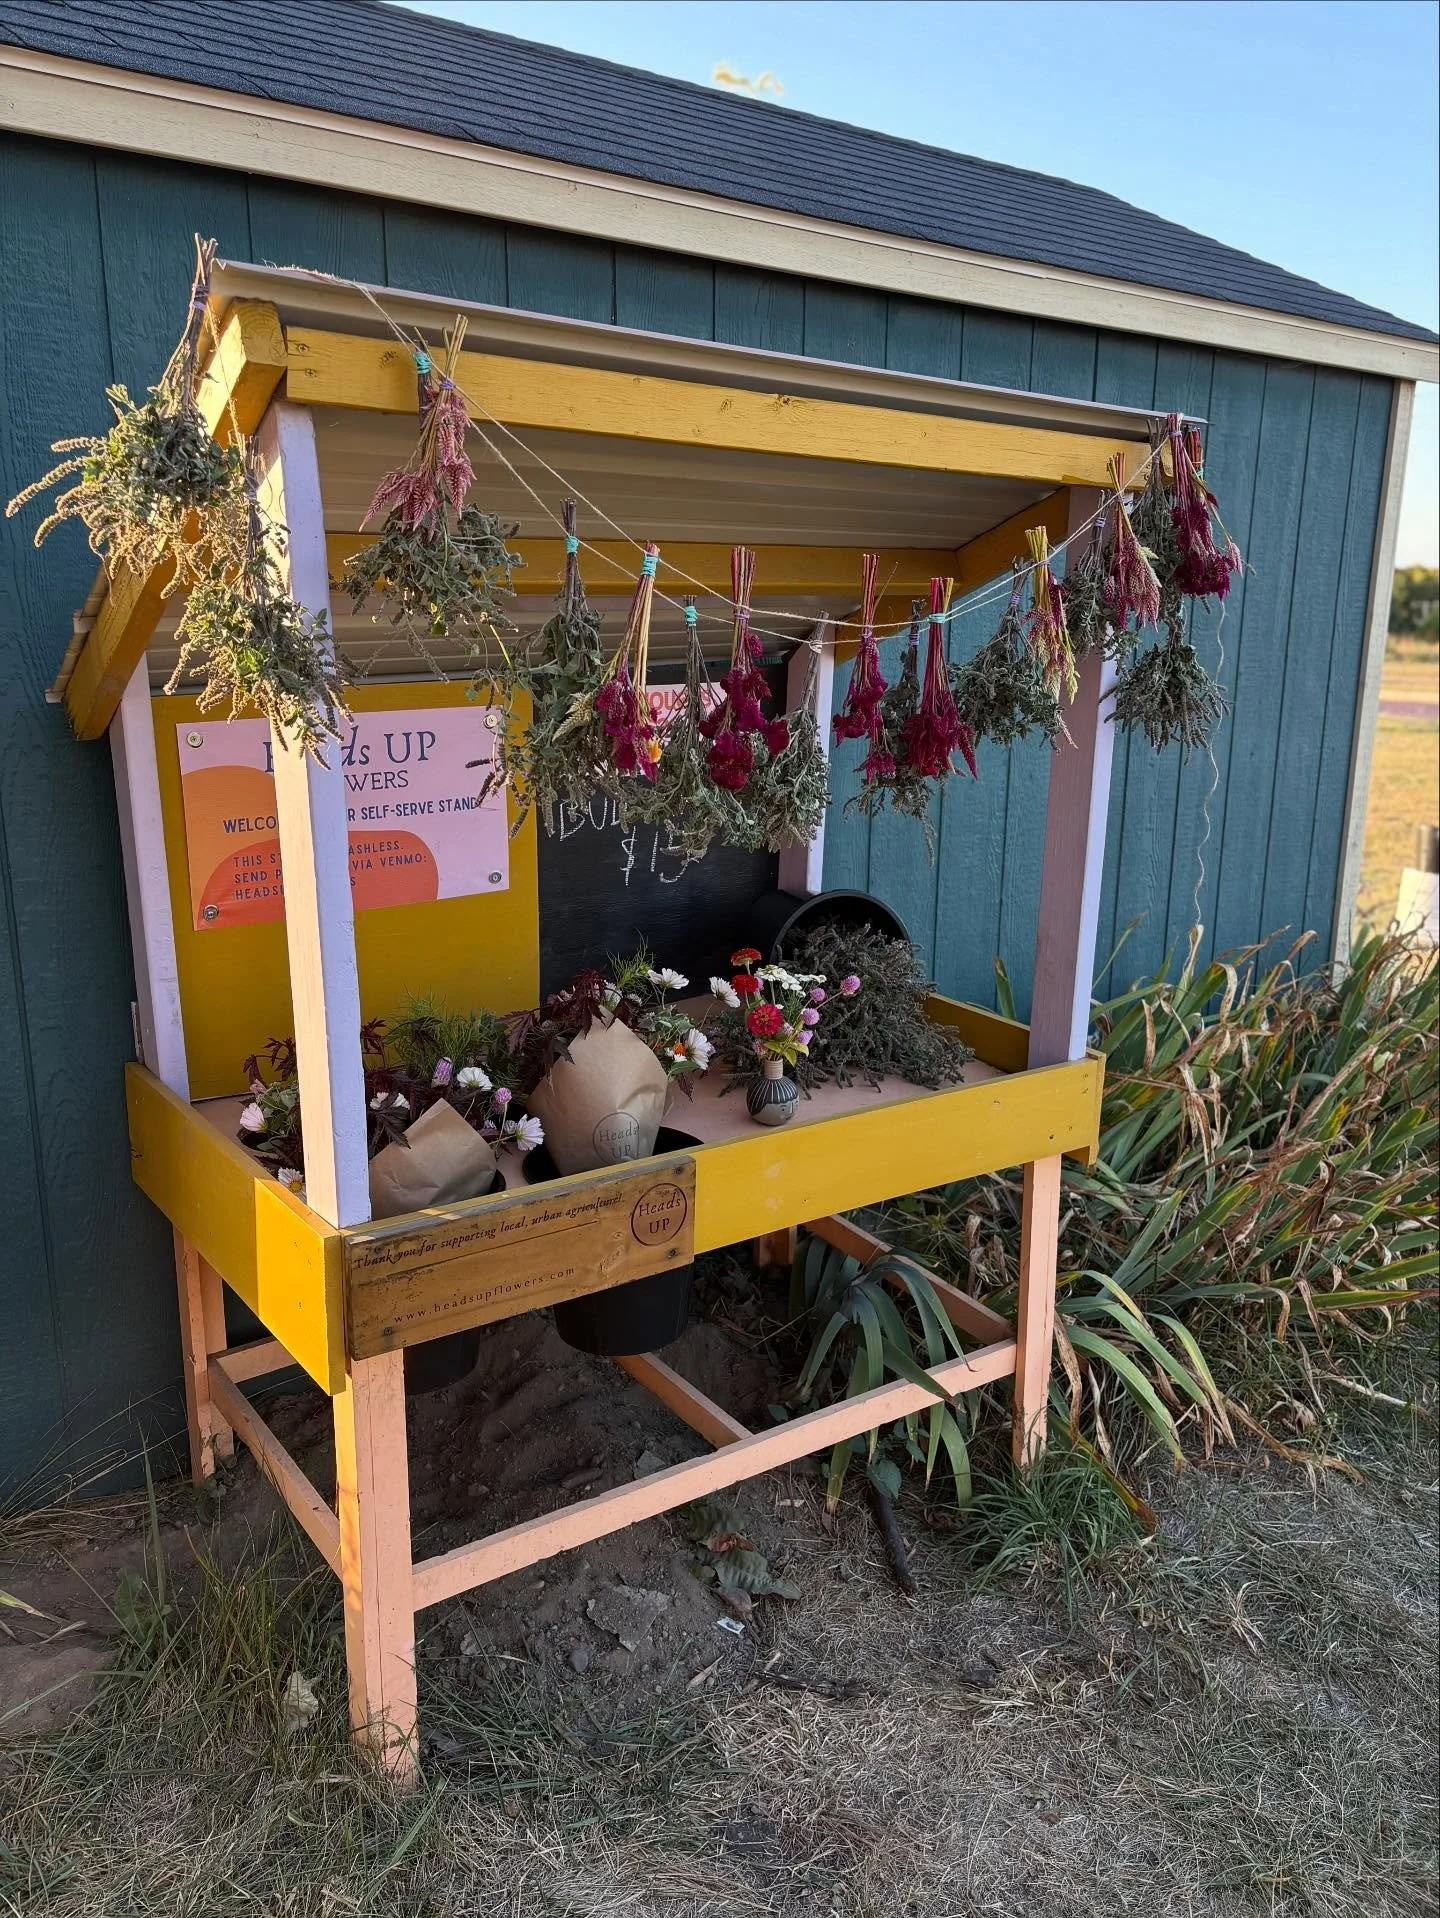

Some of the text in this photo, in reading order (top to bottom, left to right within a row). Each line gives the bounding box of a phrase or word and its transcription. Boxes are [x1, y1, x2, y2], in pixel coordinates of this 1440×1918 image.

[383, 730, 437, 764] UP
[344, 770, 409, 792] WERS
[222, 815, 277, 833] WELCO
[361, 801, 434, 821] SELF-SERVE
[233, 854, 262, 867] THIS
[348, 840, 404, 856] ASHLESS.
[234, 870, 268, 884] SEND
[352, 859, 373, 870] VIA
[380, 853, 427, 868] VENMO:
[599, 1121, 639, 1142] Heads
[638, 1191, 682, 1218] Heads
[353, 1248, 394, 1270] Thank
[394, 1247, 417, 1264] you
[416, 1240, 438, 1257] for
[440, 1228, 497, 1249] supporting
[500, 1215, 529, 1233] local,
[531, 1210, 563, 1225] urban
[648, 1217, 671, 1234] UP
[393, 1267, 575, 1323] www.headsupflowers.com
